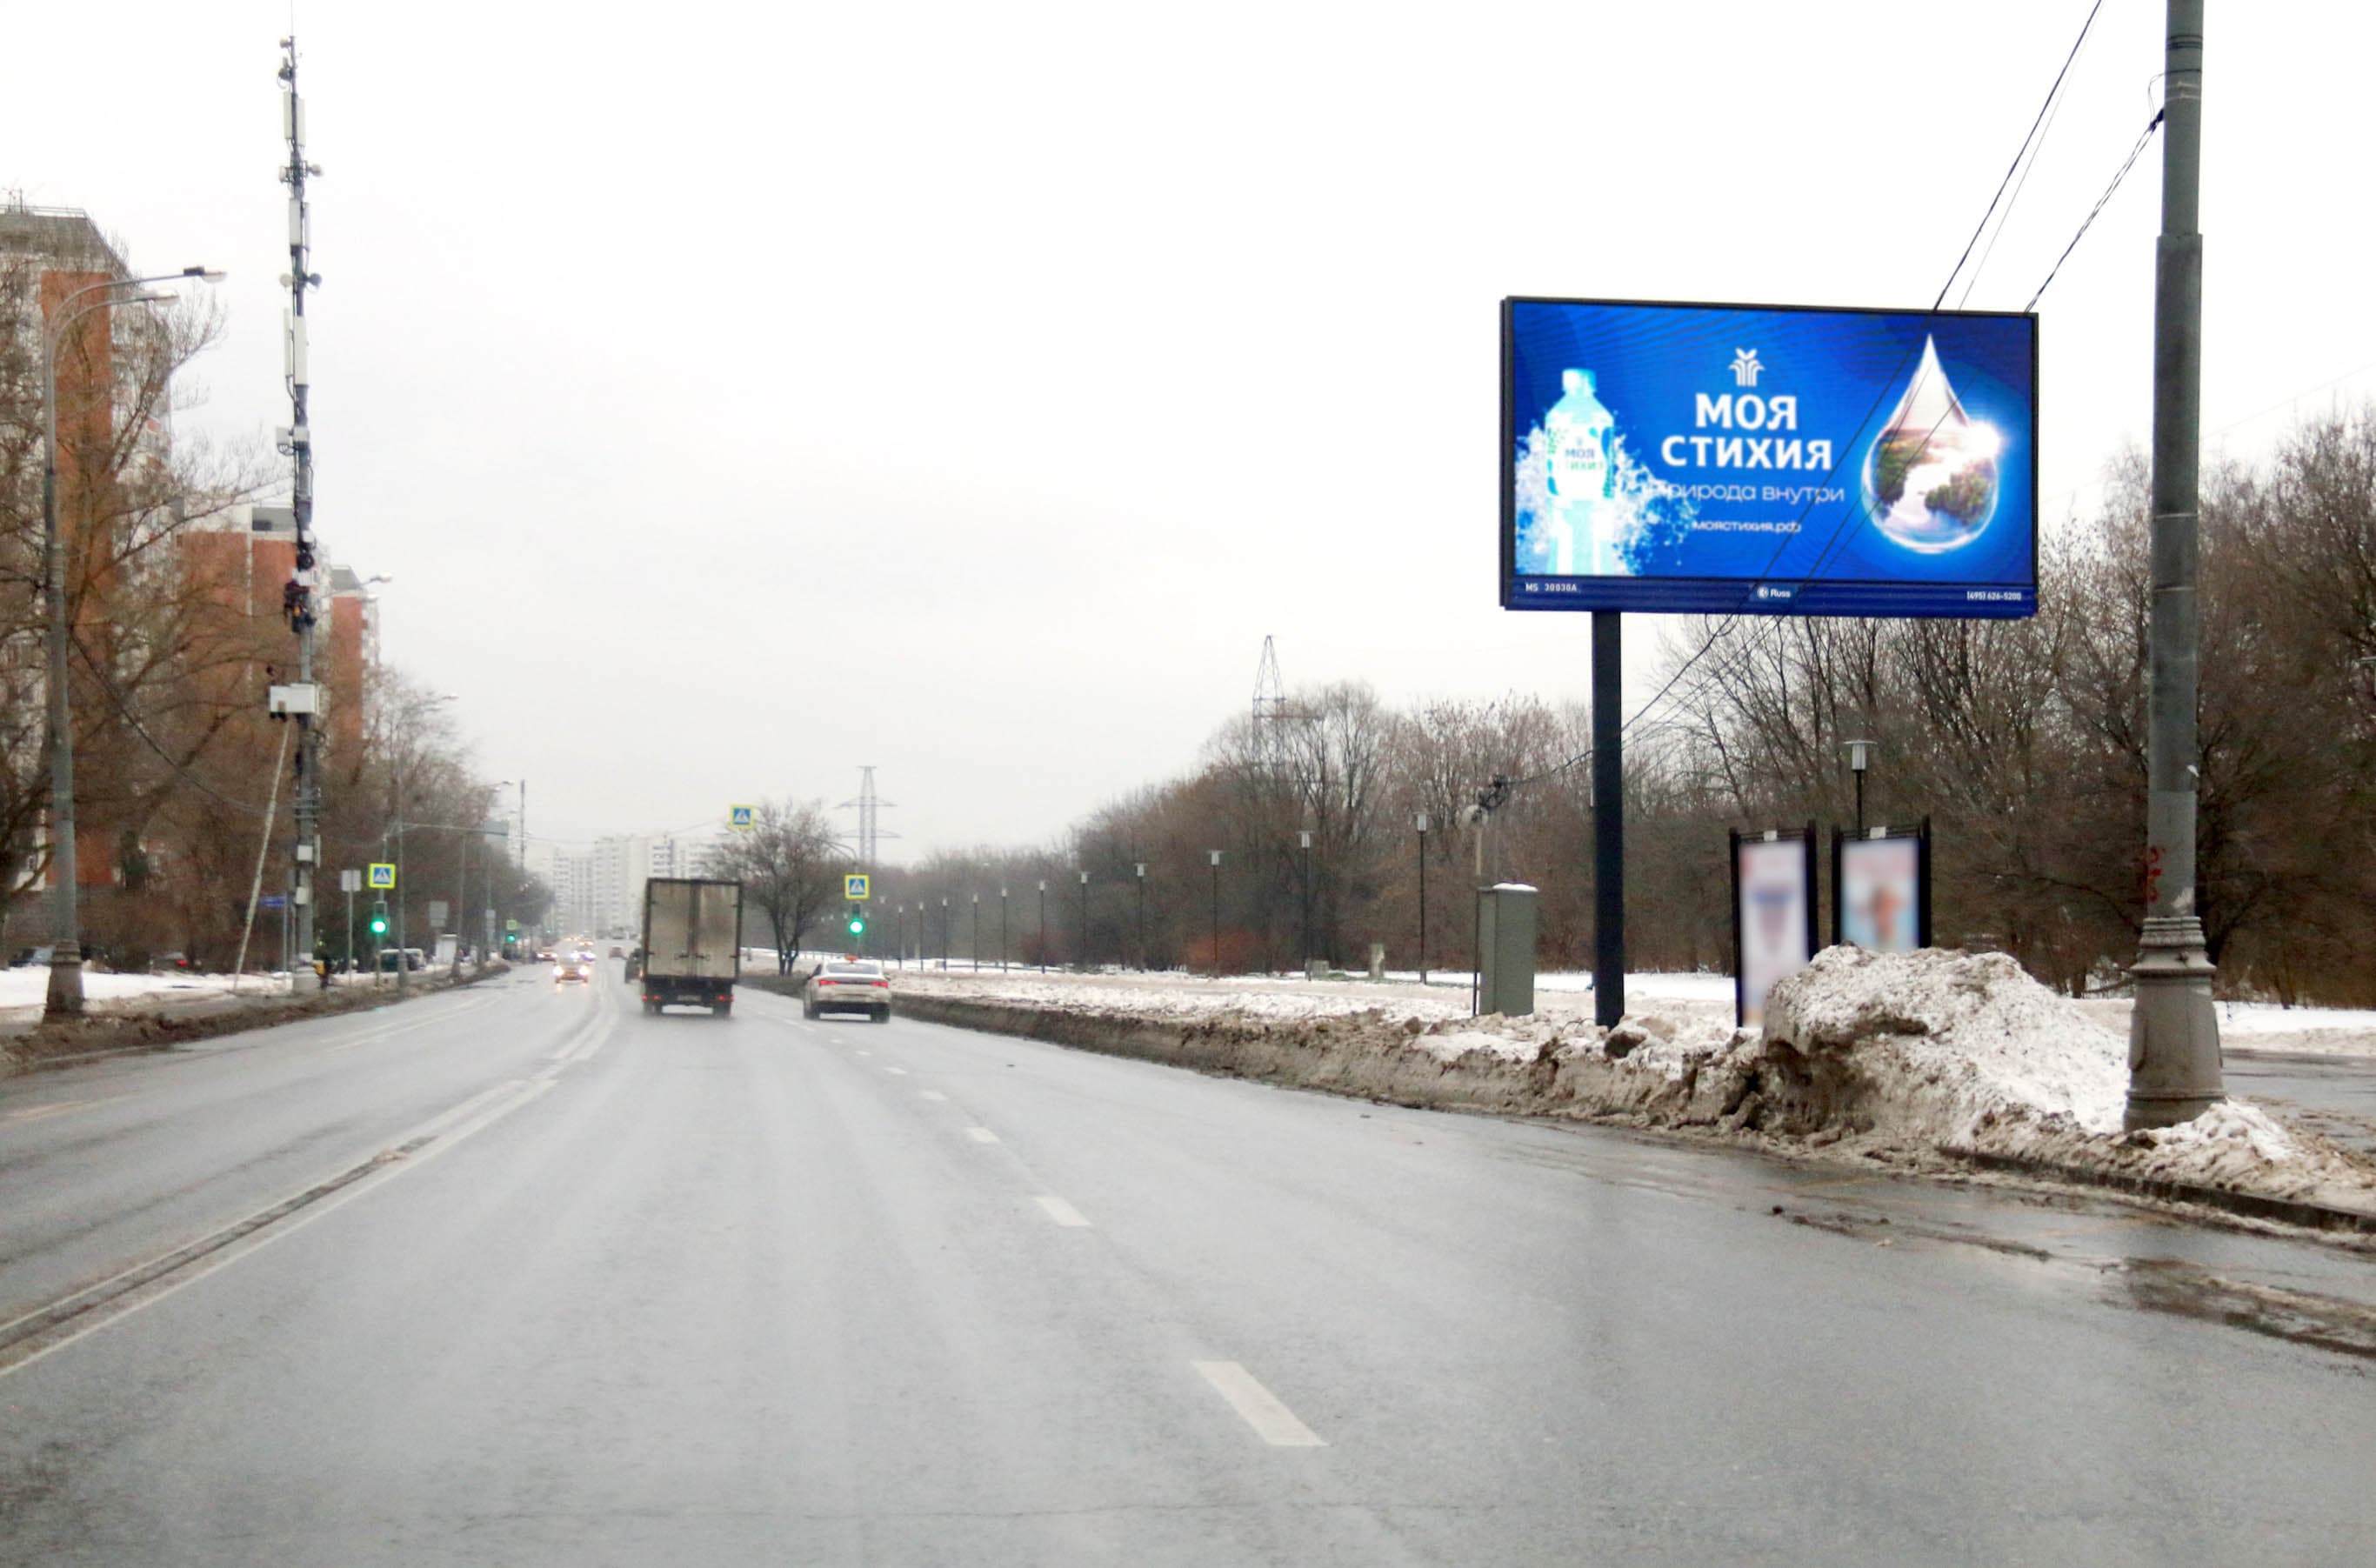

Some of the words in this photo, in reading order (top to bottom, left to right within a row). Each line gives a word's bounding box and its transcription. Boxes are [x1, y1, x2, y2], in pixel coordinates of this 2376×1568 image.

[1696, 393, 1798, 430] МОЯ
[1661, 436, 1832, 470] СТИХИЯ
[1762, 485, 1845, 505] внутри
